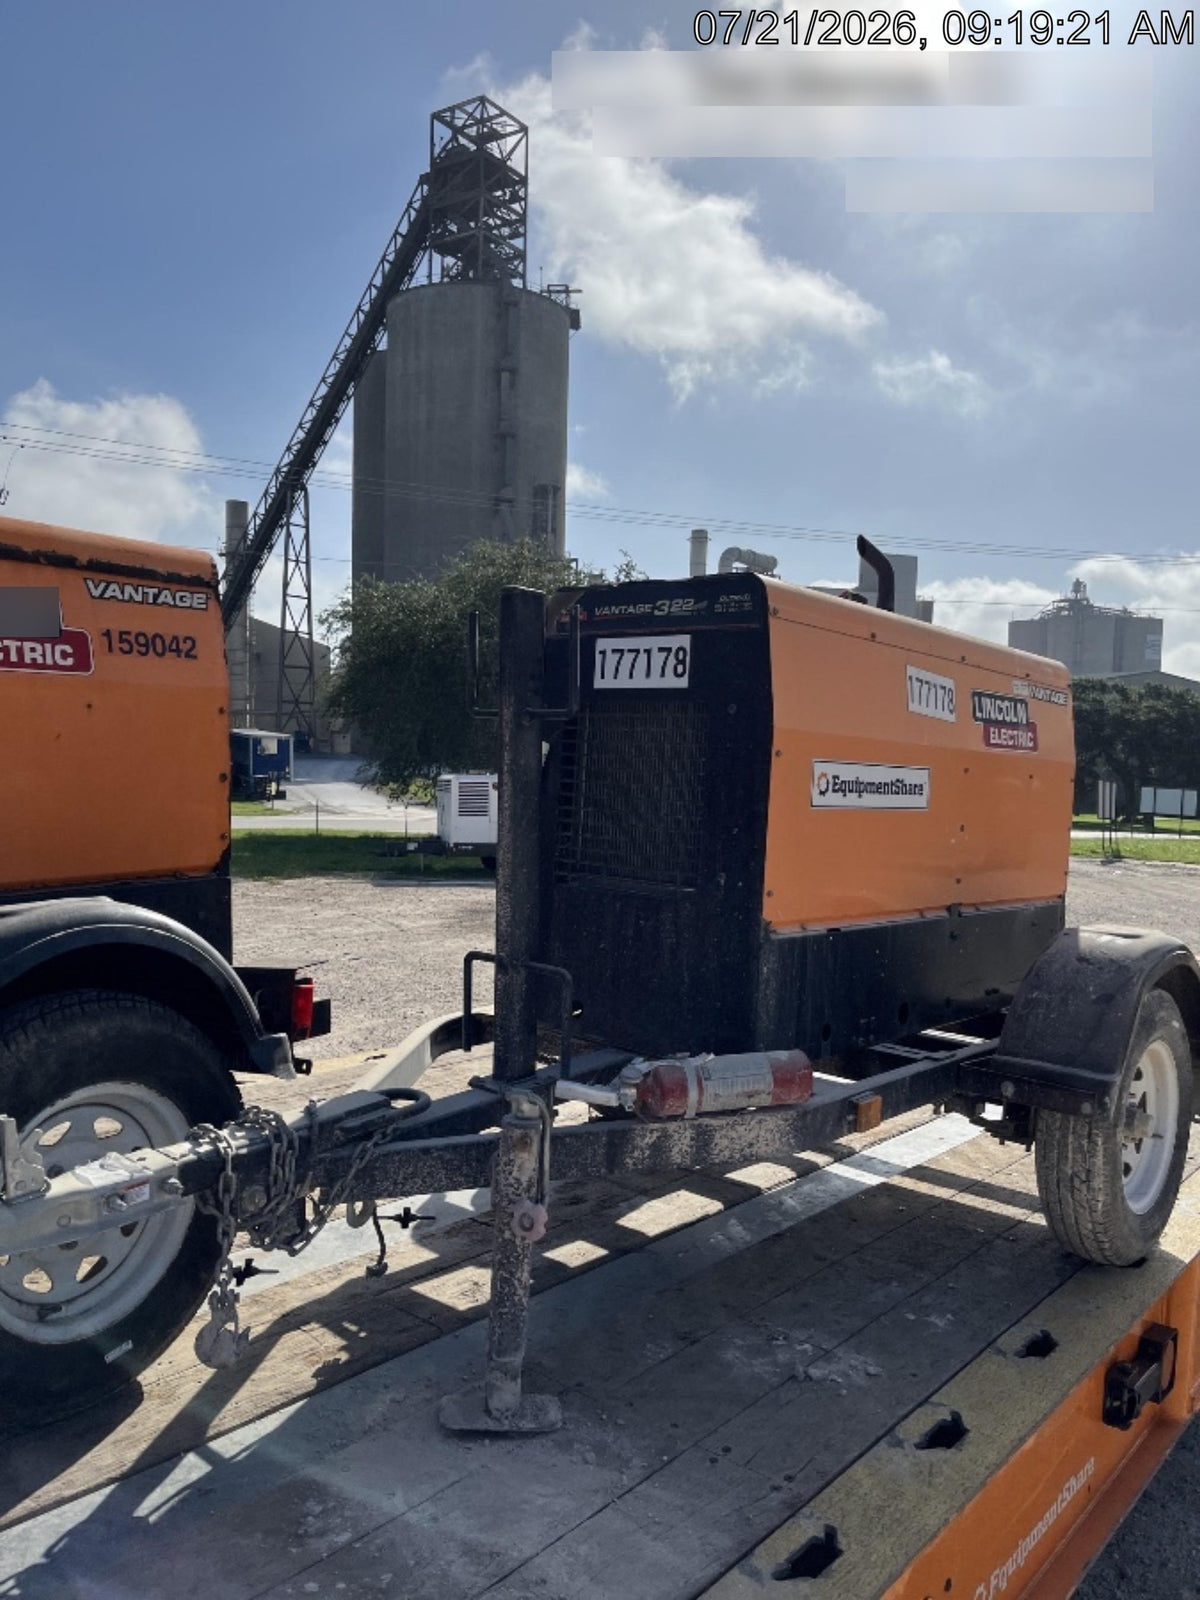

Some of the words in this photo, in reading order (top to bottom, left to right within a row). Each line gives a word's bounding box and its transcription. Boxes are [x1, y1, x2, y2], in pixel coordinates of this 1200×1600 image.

[85, 578, 208, 609] VANTAGE
[594, 604, 653, 616] VANTAGE
[101, 628, 198, 659] 159042
[598, 646, 688, 680] 177178
[908, 675, 956, 715] 177178
[973, 695, 1028, 725] LINCOLN
[989, 727, 1035, 747] ELECTRIC
[831, 774, 924, 799] EquipmentShare
